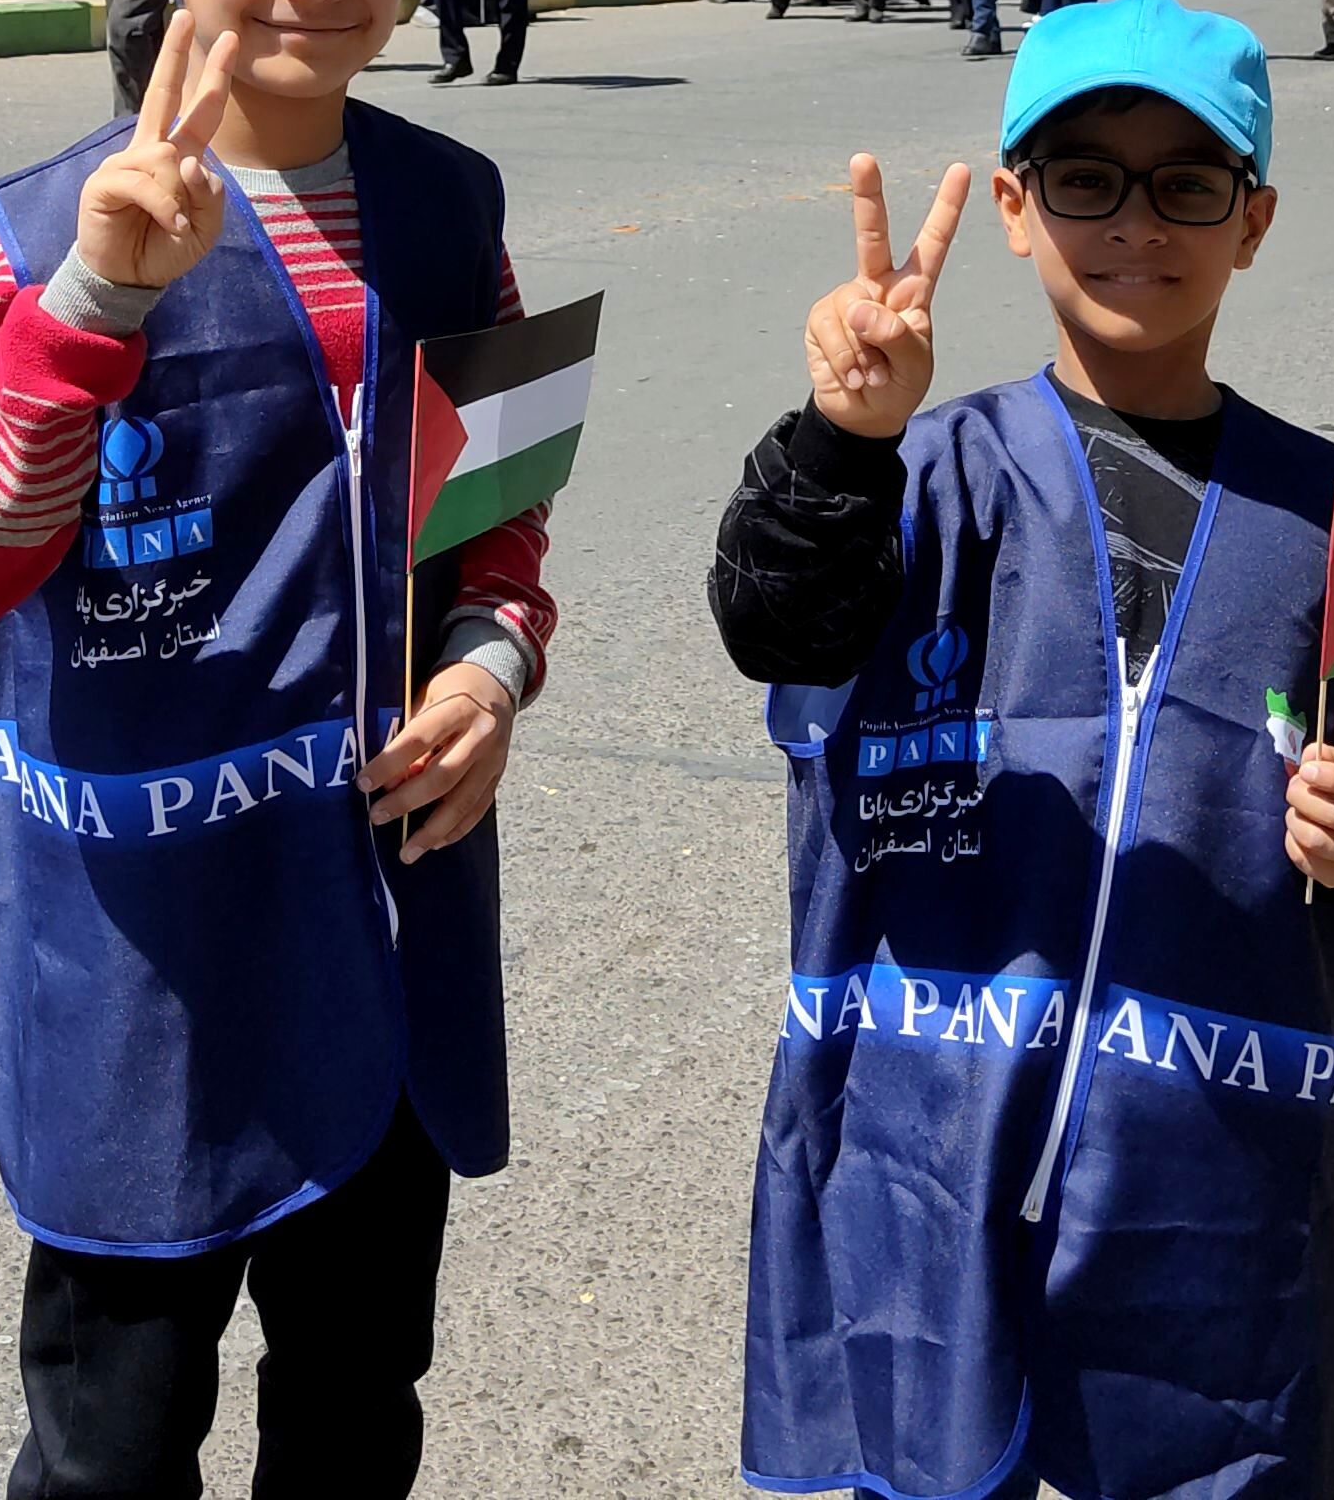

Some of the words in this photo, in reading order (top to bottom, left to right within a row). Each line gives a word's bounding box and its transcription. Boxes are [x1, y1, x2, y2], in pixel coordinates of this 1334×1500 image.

[87, 521, 206, 563] ANA
[94, 569, 213, 623] خبرگزاری
[70, 631, 147, 669] اصفهان
[159, 612, 221, 660] استان
[866, 727, 988, 770] PANA
[21, 760, 115, 839] ANA
[140, 726, 357, 837] PANA
[887, 779, 984, 819] خبرگزاری
[859, 791, 888, 825] پانا
[854, 827, 932, 874] اصفهان
[940, 828, 982, 864] استان
[779, 973, 878, 1042] NA
[898, 977, 1065, 1049] PANA
[1097, 996, 1270, 1093] ANA
